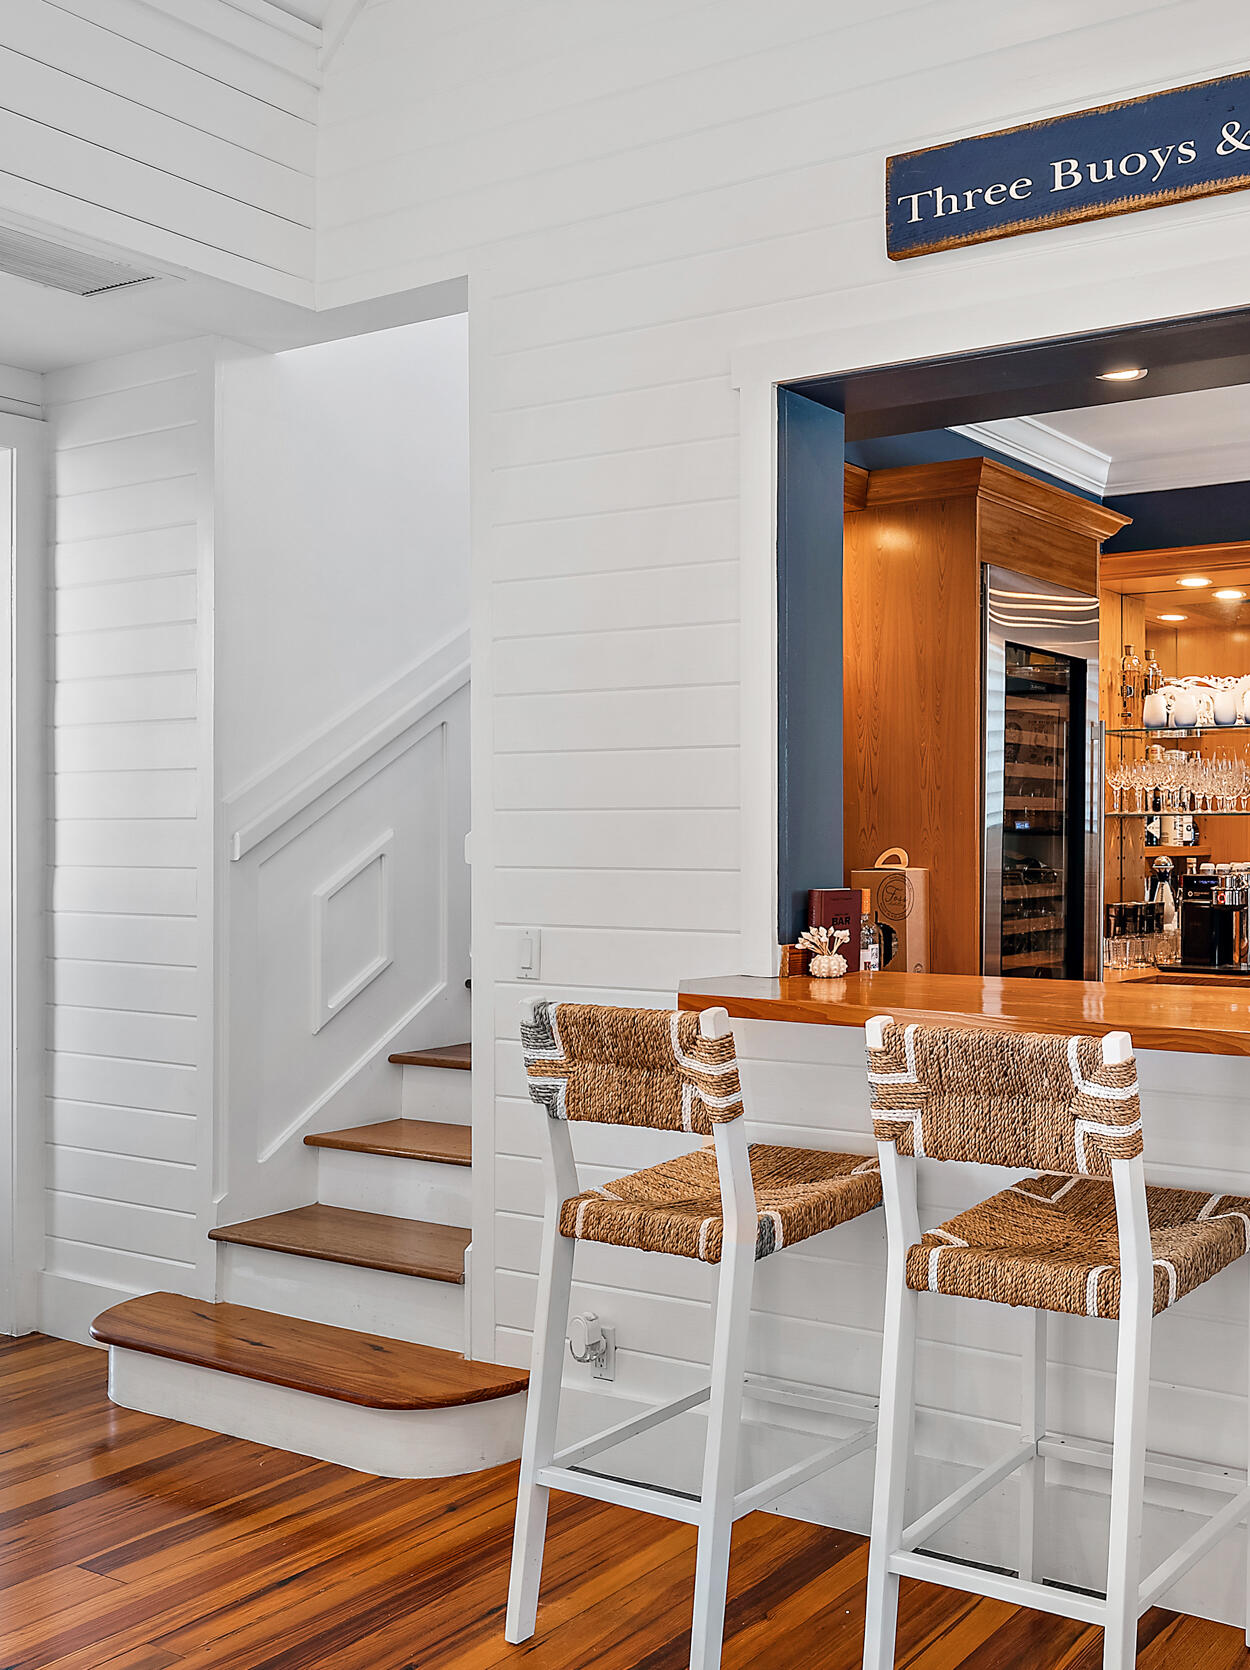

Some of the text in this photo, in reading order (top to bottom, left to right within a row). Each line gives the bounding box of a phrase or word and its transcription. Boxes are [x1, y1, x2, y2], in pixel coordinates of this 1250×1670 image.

[897, 178, 1033, 224] Three
[1049, 141, 1197, 193] Buoys
[832, 916, 850, 926] BAR
